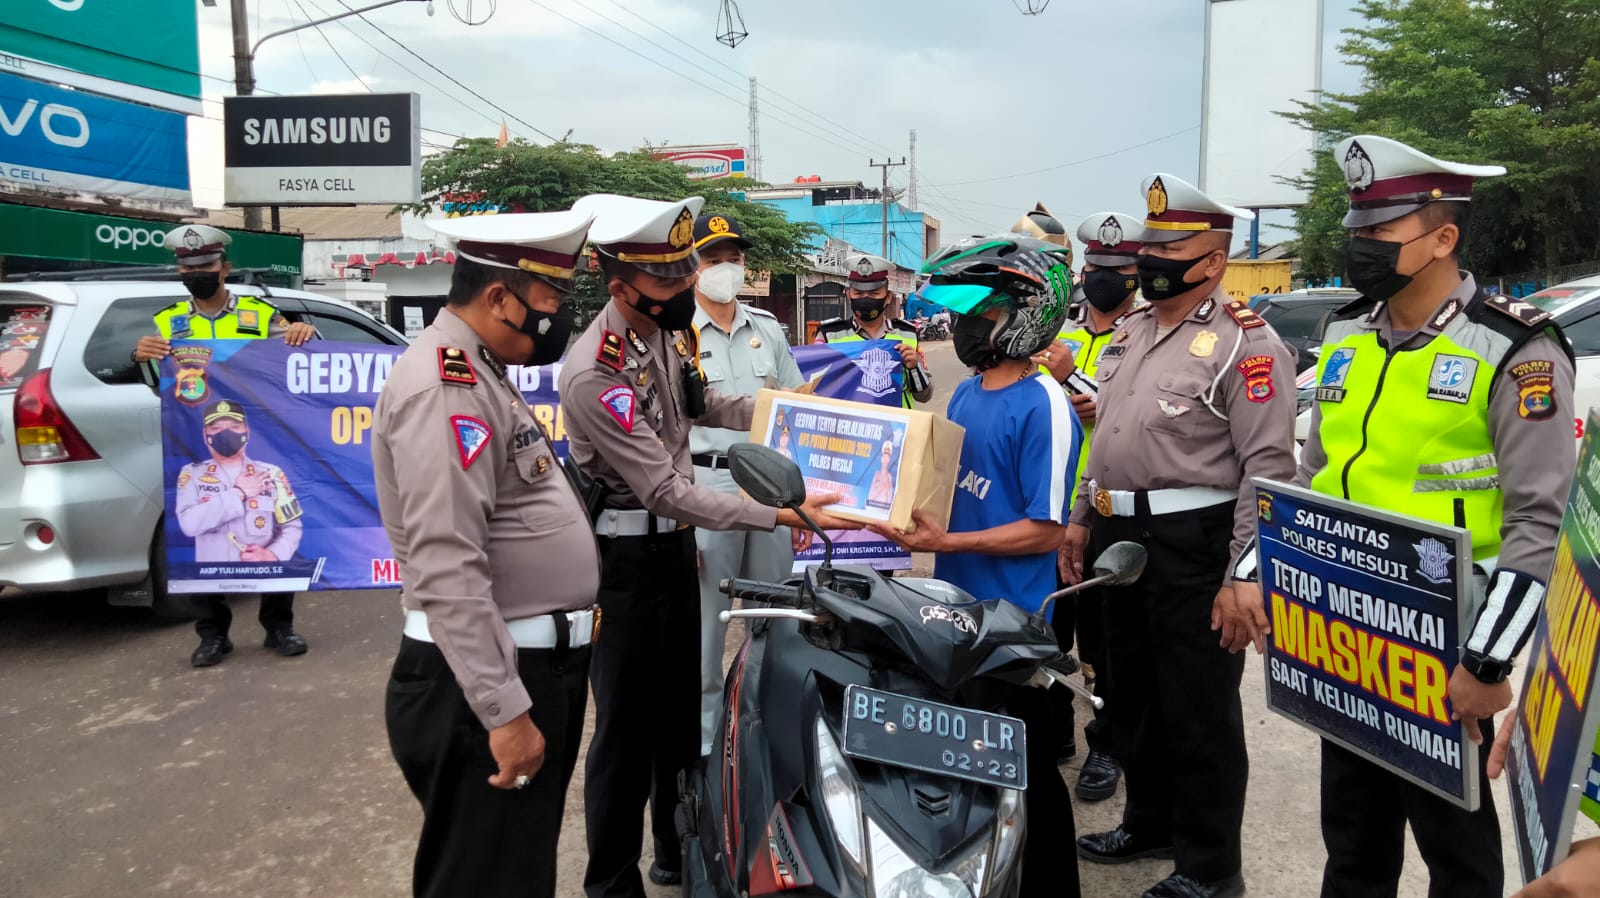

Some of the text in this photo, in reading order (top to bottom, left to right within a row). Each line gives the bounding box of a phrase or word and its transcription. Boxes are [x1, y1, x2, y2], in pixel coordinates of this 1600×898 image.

[244, 116, 391, 145] SAMSUNG
[10, 168, 51, 182] CELL
[279, 178, 357, 191] FASYA CELL
[96, 224, 166, 250] oppo
[288, 265, 300, 274] CELL
[286, 352, 401, 394] GEBYA
[1512, 361, 1551, 375] POLRES
[808, 453, 831, 469] POLRES
[1294, 509, 1390, 550] SATLANTAS
[1281, 526, 1409, 581] POLRES MESUJI
[1270, 557, 1445, 650] TETAP MEMAKAI
[1270, 591, 1451, 725] MASKER
[853, 692, 1014, 751] BE 6800 LR
[1271, 657, 1308, 696] SAAT
[1312, 677, 1381, 732] KELUAR
[1384, 711, 1461, 770] RUMAH
[775, 816, 799, 876] HONDA
